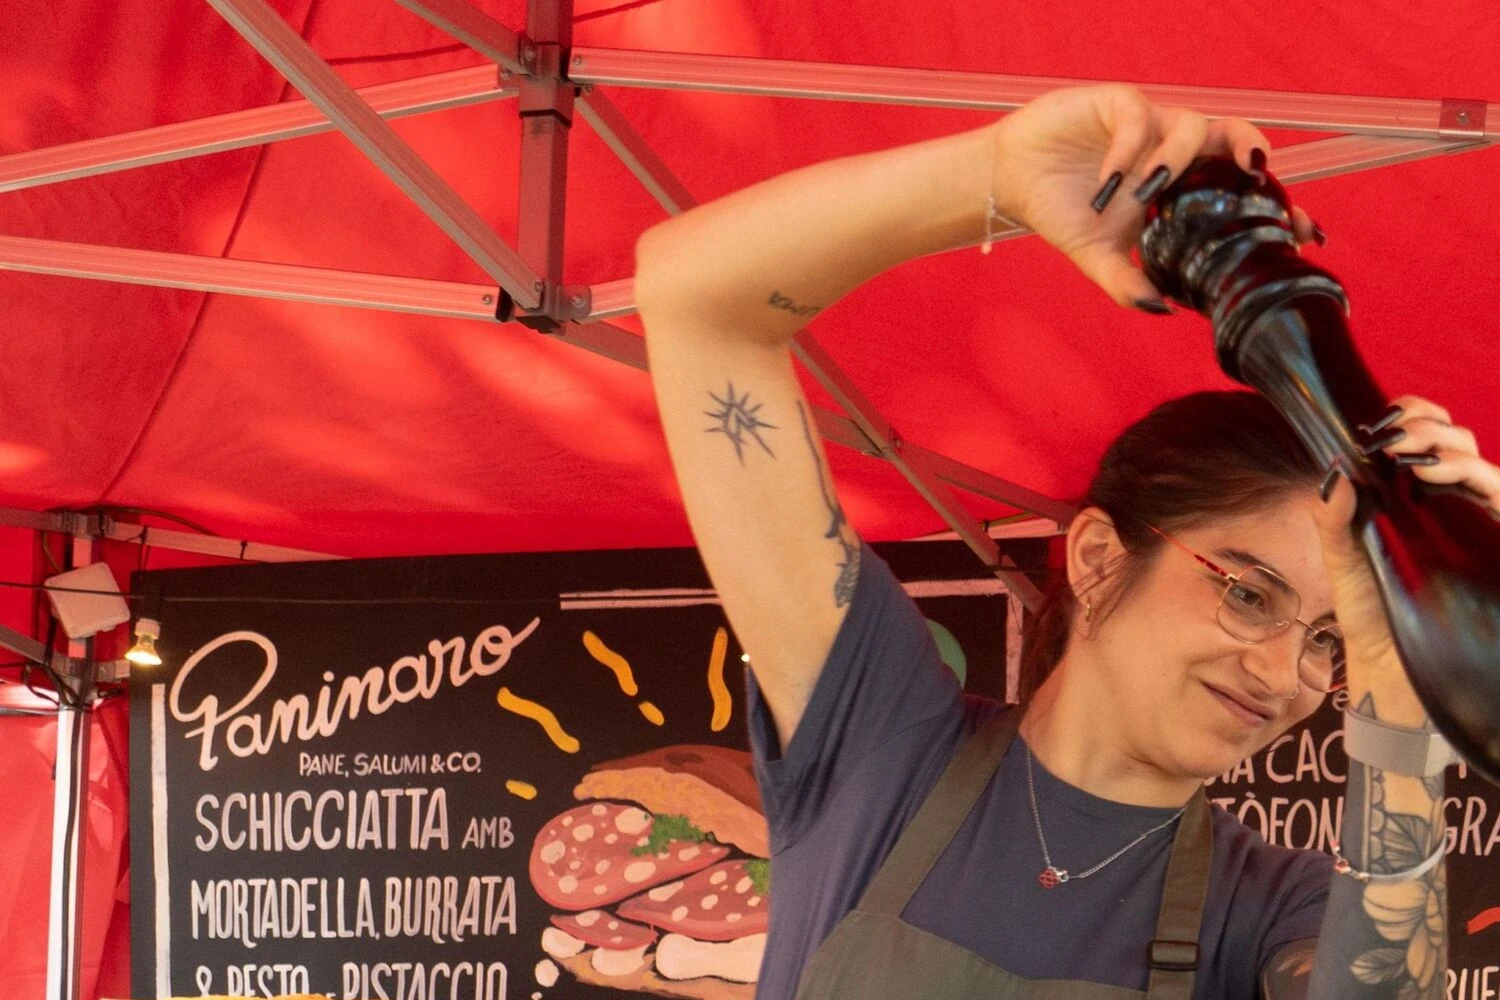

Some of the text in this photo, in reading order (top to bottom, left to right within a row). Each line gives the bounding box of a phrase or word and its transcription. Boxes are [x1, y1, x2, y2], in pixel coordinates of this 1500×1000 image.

[168, 617, 540, 771] Paninaro
[300, 753, 350, 777] PANE,
[354, 754, 426, 776] SALUMI
[195, 787, 515, 851] SCHICCIATTA AMB
[191, 876, 517, 948] MORTADELLA, BURRATA
